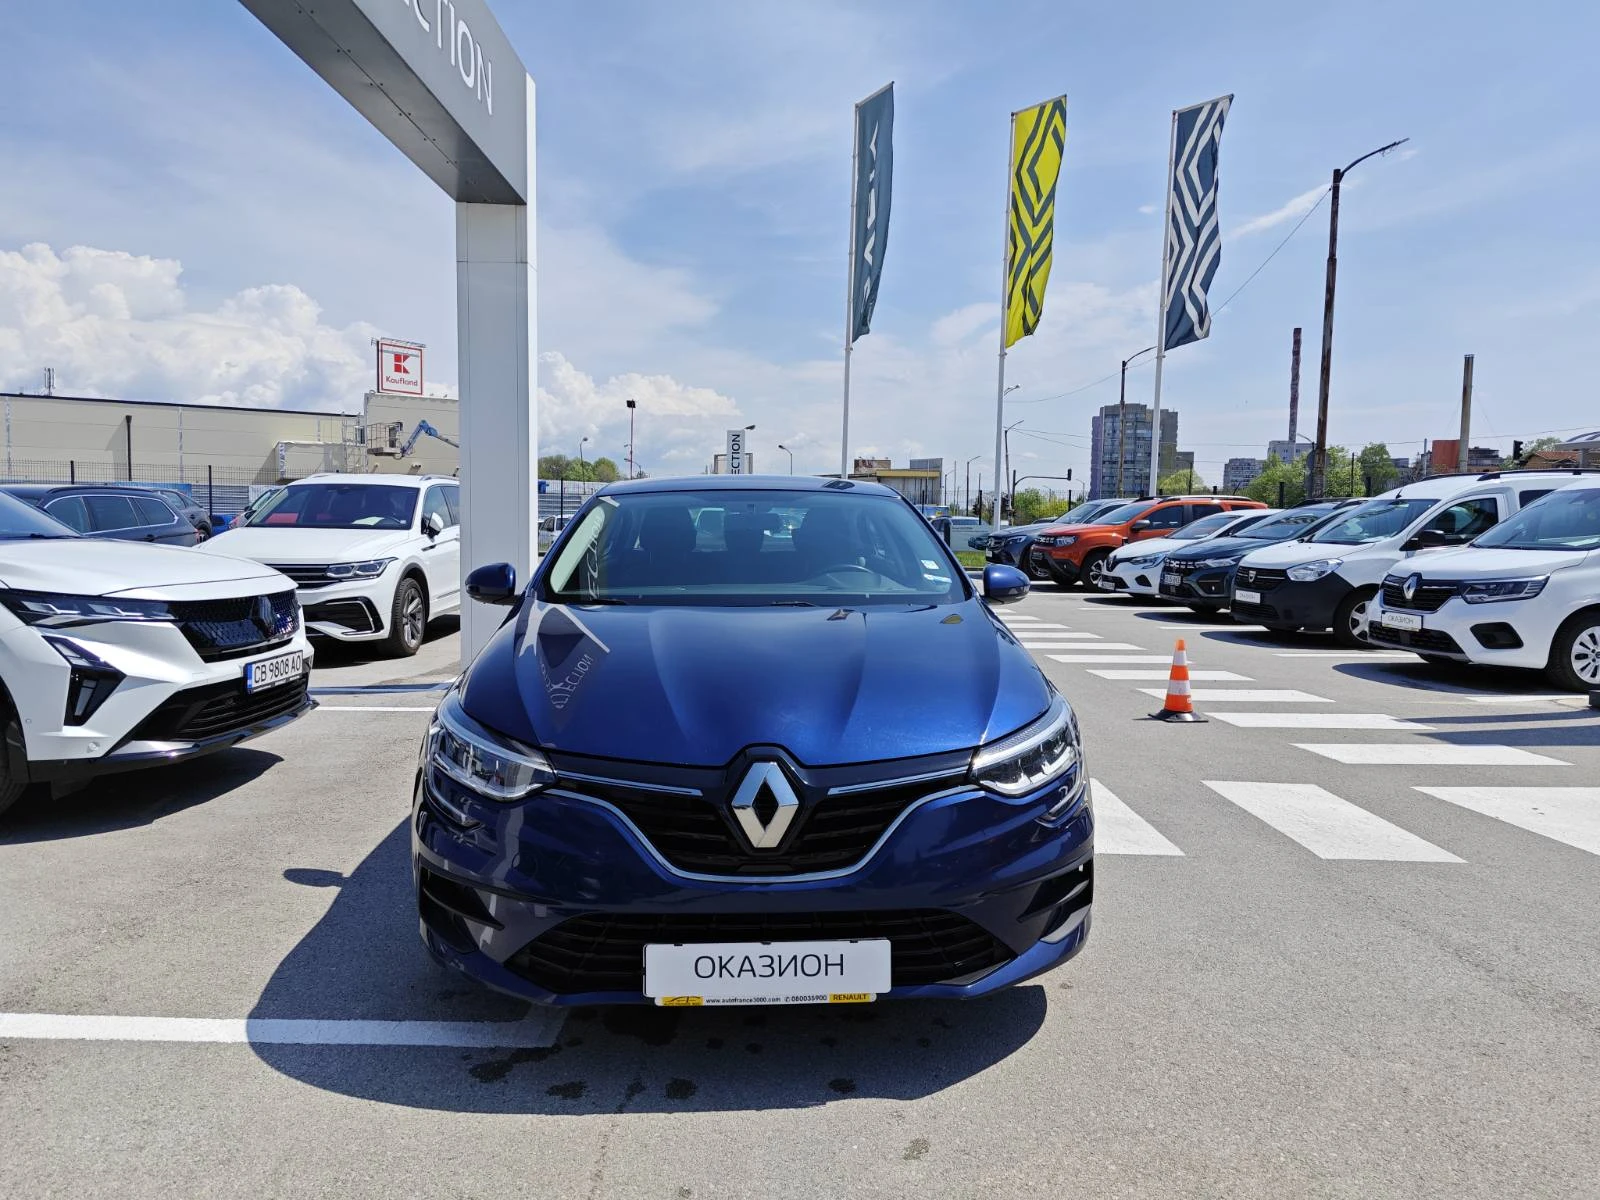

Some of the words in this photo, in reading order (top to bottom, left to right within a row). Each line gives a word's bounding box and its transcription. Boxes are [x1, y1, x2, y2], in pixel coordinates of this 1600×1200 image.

[404, 0, 493, 116] CTION
[385, 375, 418, 387] Kaufland
[254, 664, 267, 684] CB
[290, 654, 302, 673] AO
[694, 953, 845, 979] ОКАЗИОН
[832, 993, 868, 1001] RENAULT
